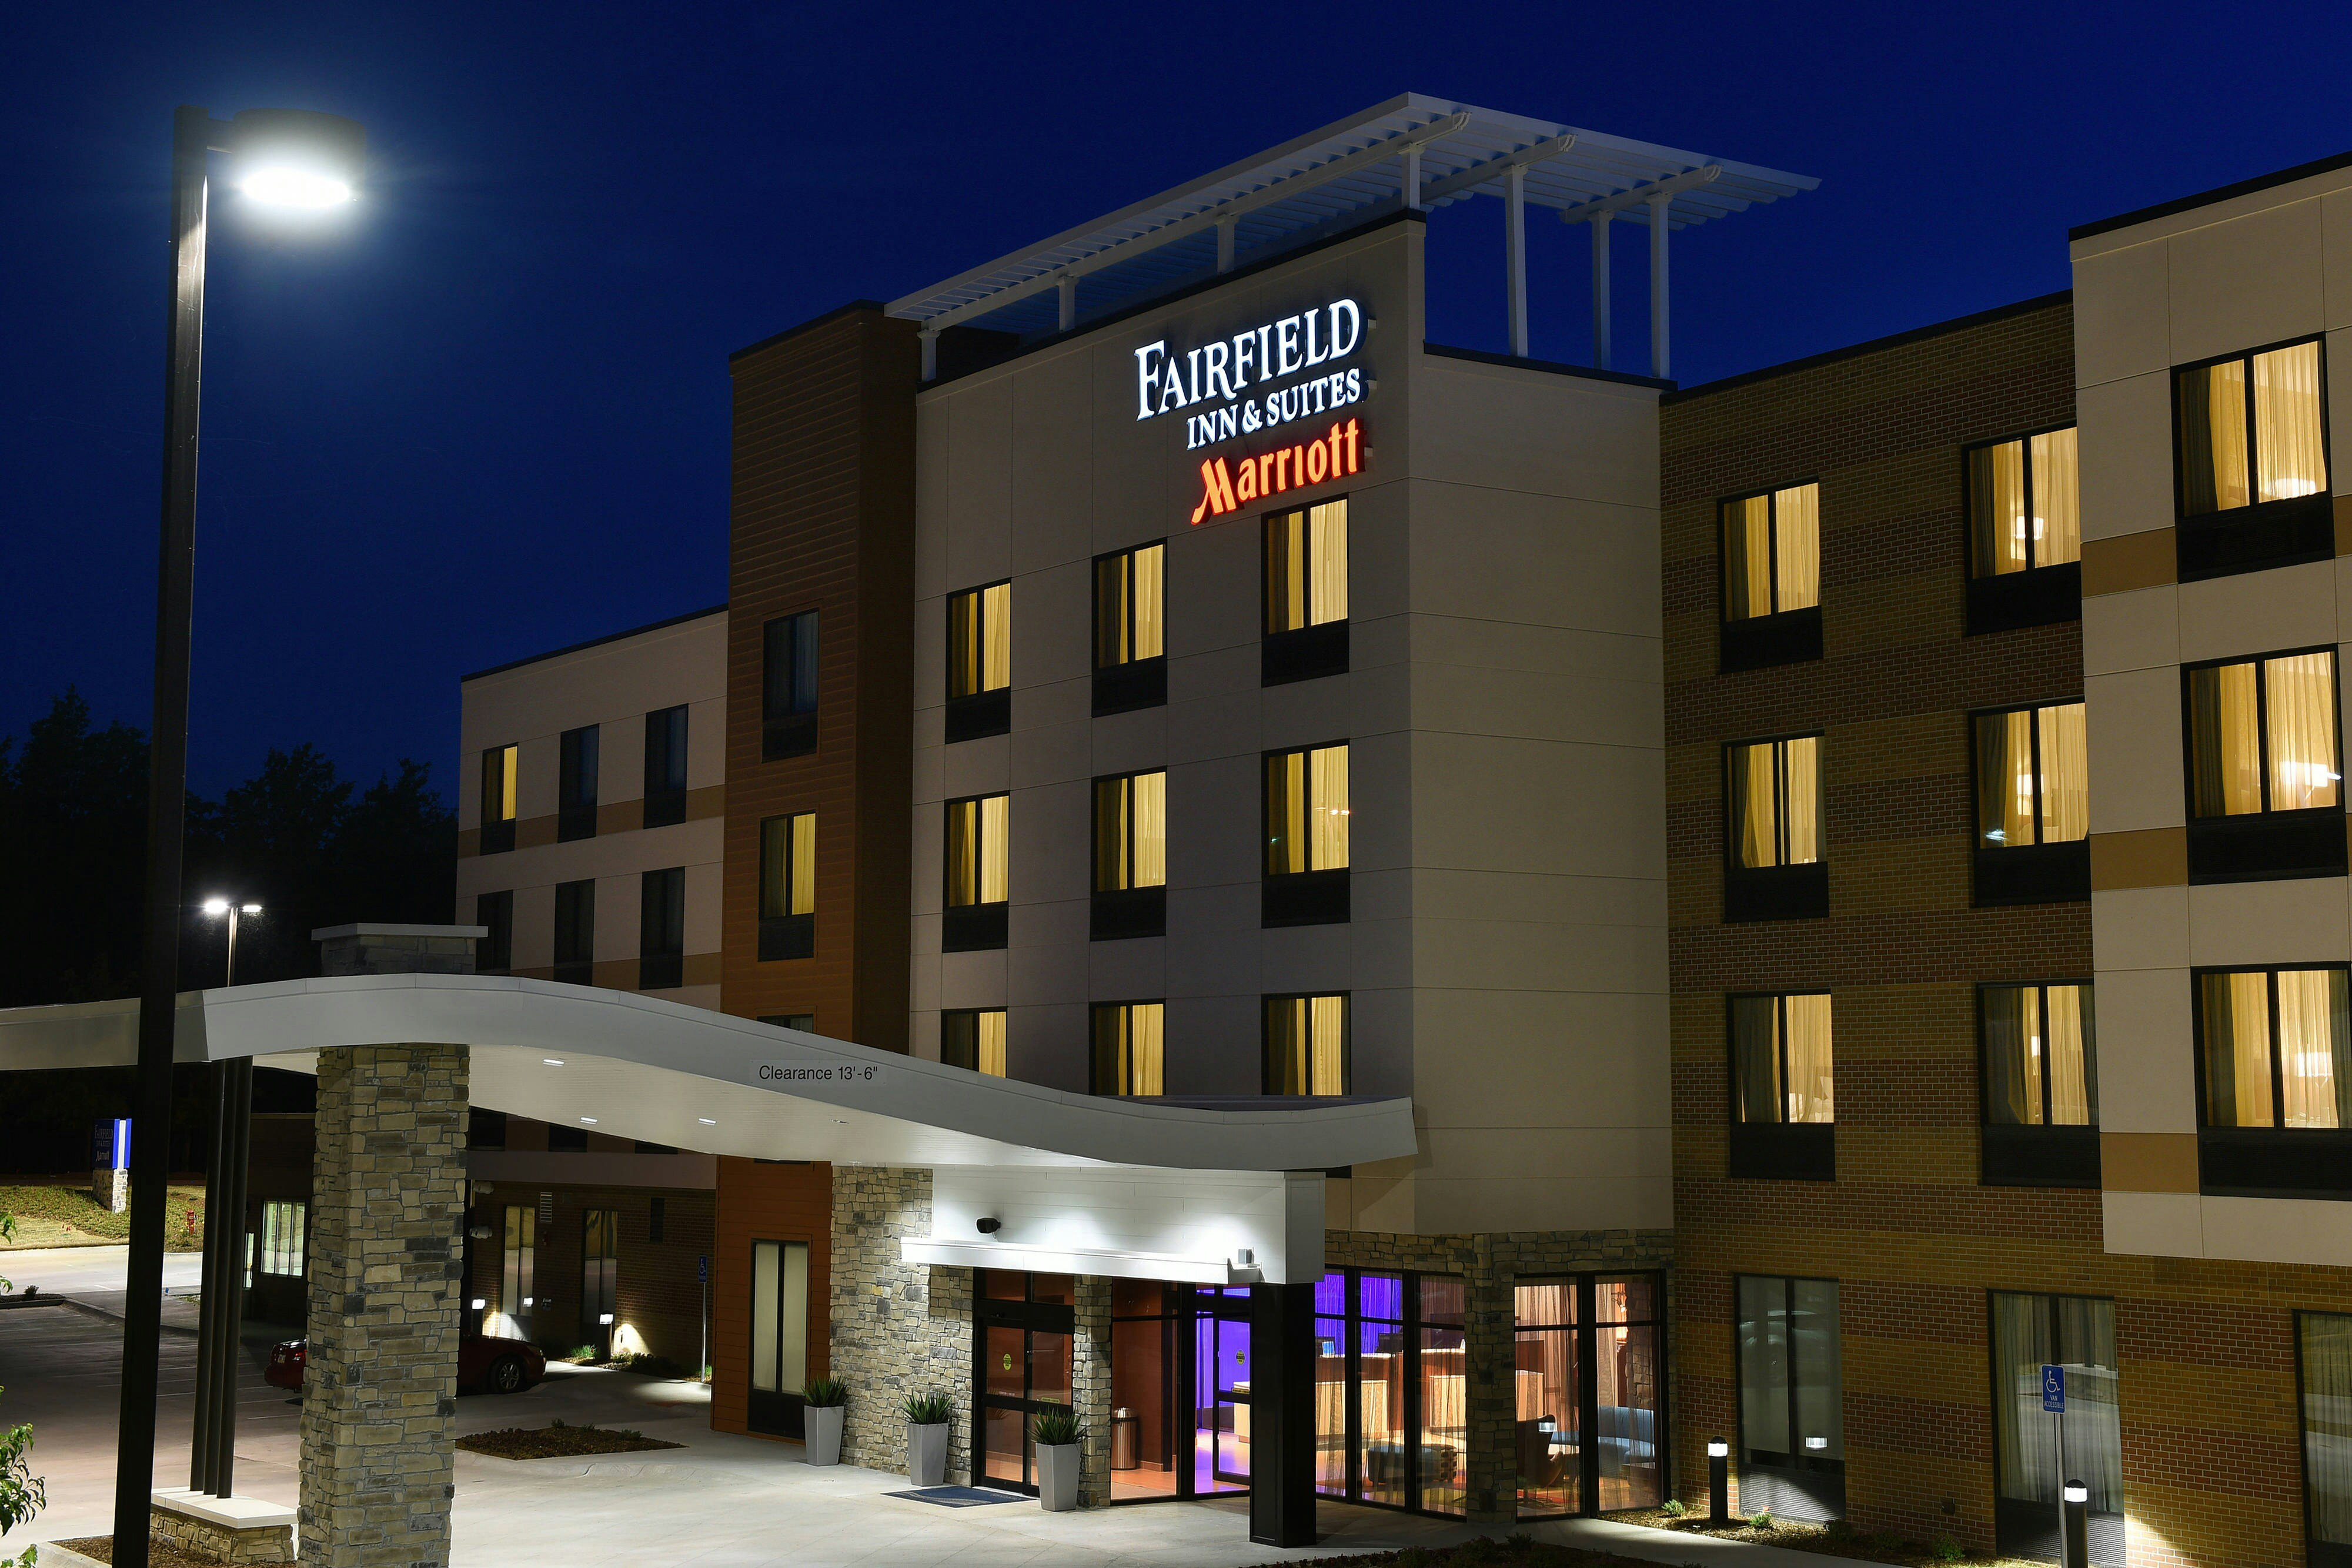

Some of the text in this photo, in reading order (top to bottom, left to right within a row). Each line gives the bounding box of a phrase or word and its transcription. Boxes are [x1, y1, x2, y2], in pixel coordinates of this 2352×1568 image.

[1134, 299, 1361, 422] FAIRFIELD
[1187, 368, 1361, 450] INN & SUITES
[1191, 418, 1359, 524] Marriott
[759, 1065, 833, 1080] Clearance
[2044, 1400, 2064, 1409] ACCESSIBLE
